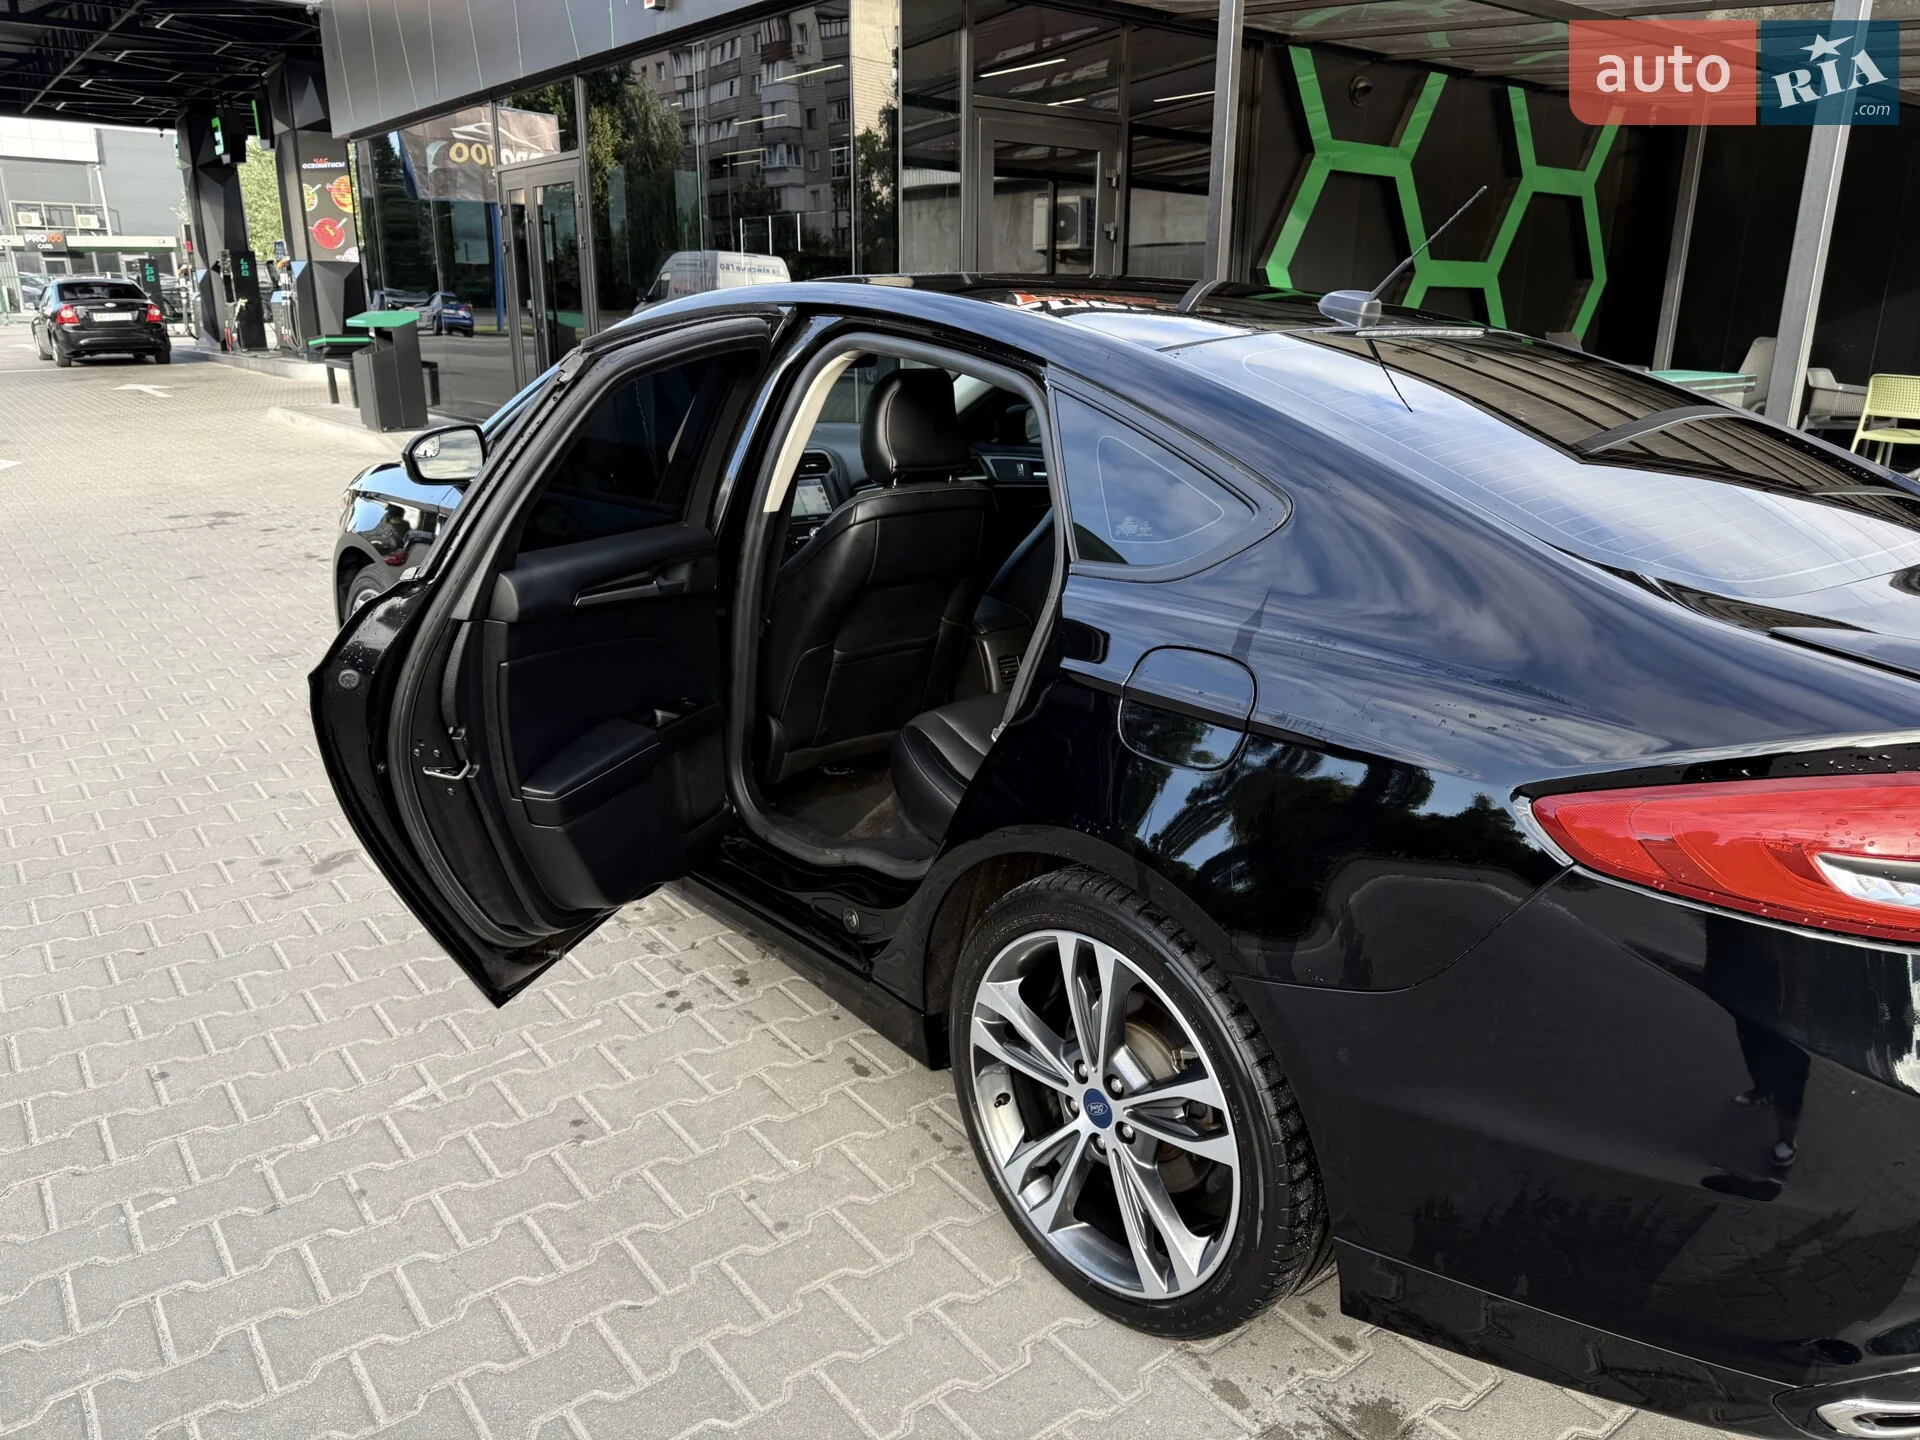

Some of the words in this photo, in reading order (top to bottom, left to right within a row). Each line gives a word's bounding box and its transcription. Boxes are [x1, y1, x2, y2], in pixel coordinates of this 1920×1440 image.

[24, 233, 63, 243] PRO100
[145, 263, 156, 282] LPG
[240, 258, 250, 277] LPG
